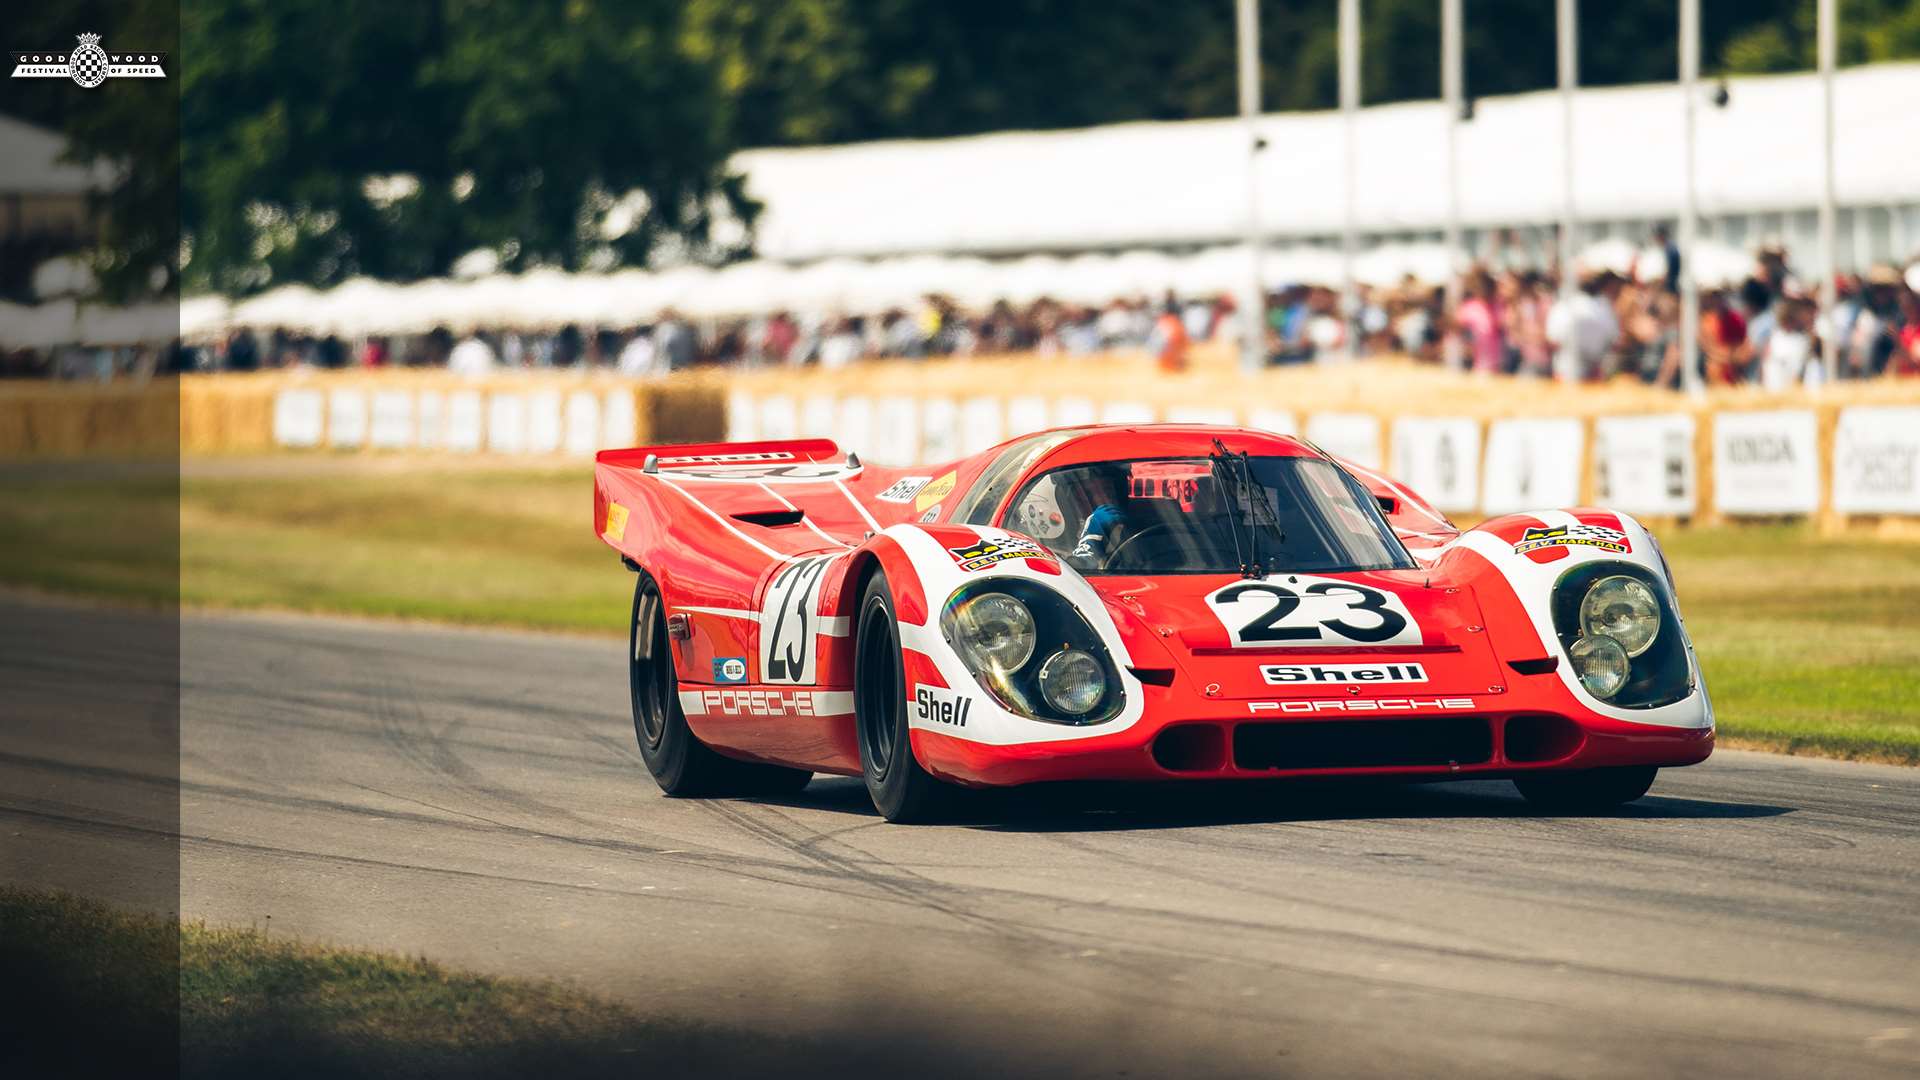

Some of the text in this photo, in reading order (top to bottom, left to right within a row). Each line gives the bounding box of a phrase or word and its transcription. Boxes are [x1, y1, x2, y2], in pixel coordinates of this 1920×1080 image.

[881, 479, 927, 500] Shell
[1555, 538, 1623, 552] MARCHAL
[768, 555, 832, 683] 23
[1214, 581, 1408, 644] 23
[1265, 664, 1425, 685] Shell
[703, 691, 814, 716] PORSCHE
[917, 688, 973, 727] Shell
[1247, 698, 1476, 714] PORSCHE
